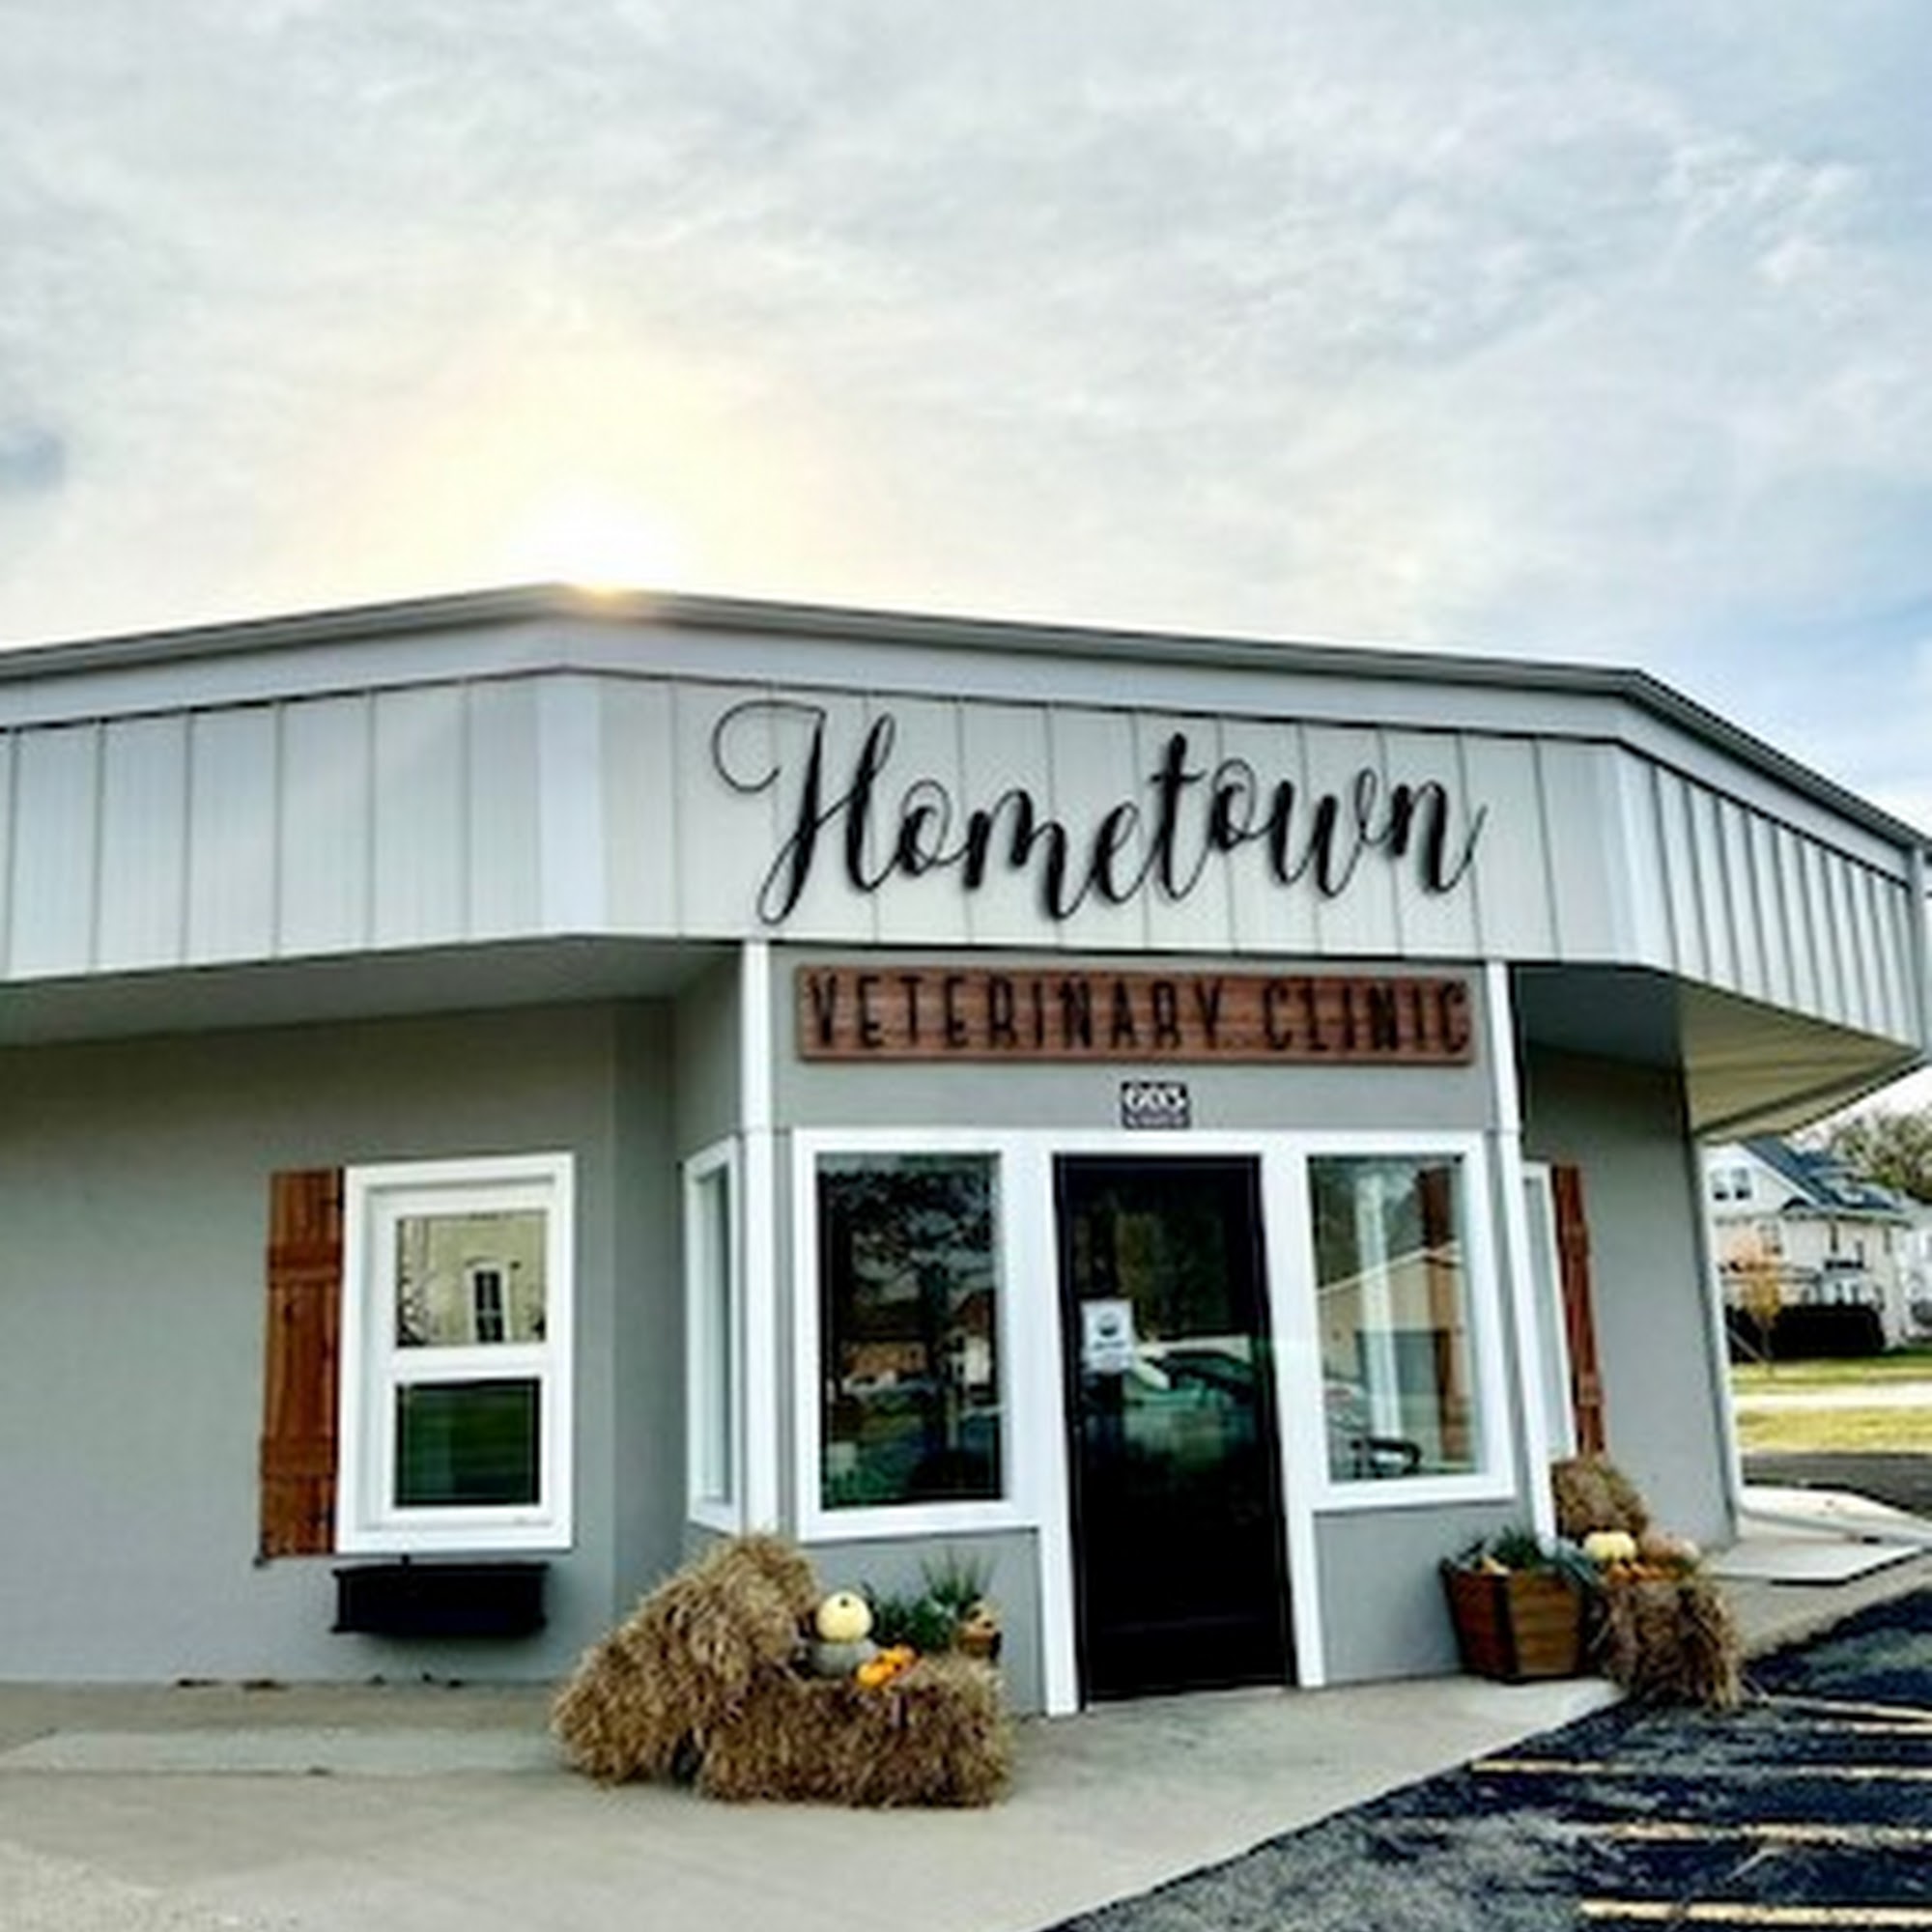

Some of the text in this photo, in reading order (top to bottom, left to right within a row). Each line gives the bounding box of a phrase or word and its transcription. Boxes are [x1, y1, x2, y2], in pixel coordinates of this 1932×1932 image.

[713, 699, 1487, 924] Hometown
[808, 973, 1469, 1054] VETERINARY CLINIC
